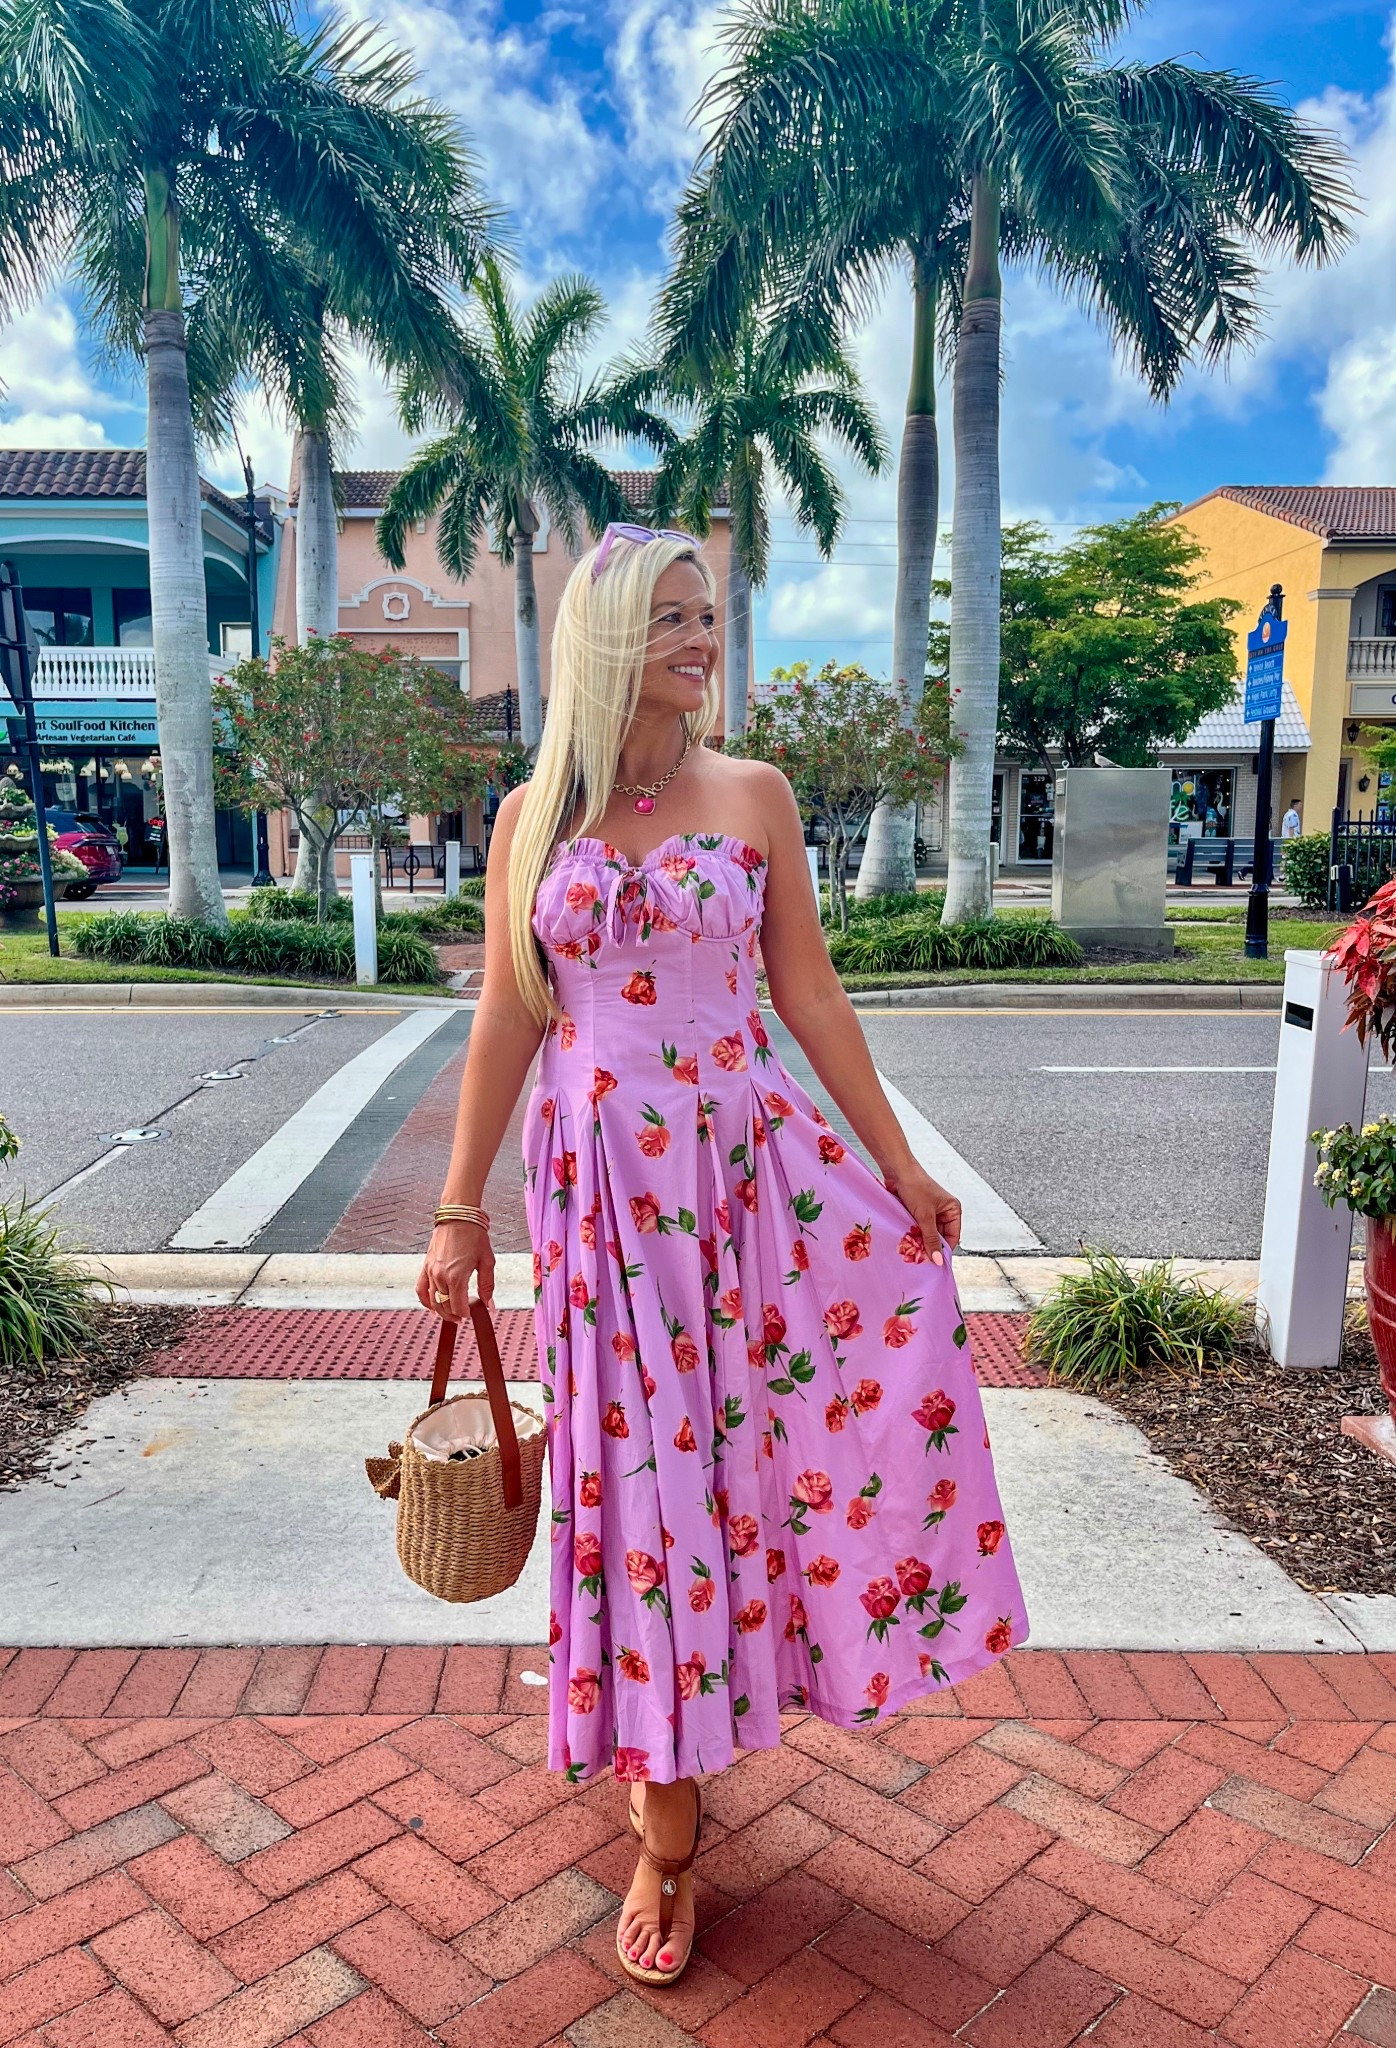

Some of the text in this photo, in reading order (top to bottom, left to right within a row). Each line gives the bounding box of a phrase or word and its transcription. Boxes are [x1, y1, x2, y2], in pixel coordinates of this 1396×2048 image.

[50, 719, 106, 731] SoulFood
[110, 719, 156, 731] Kitchen
[70, 734, 116, 743] Vegetarian
[117, 733, 136, 741] Café
